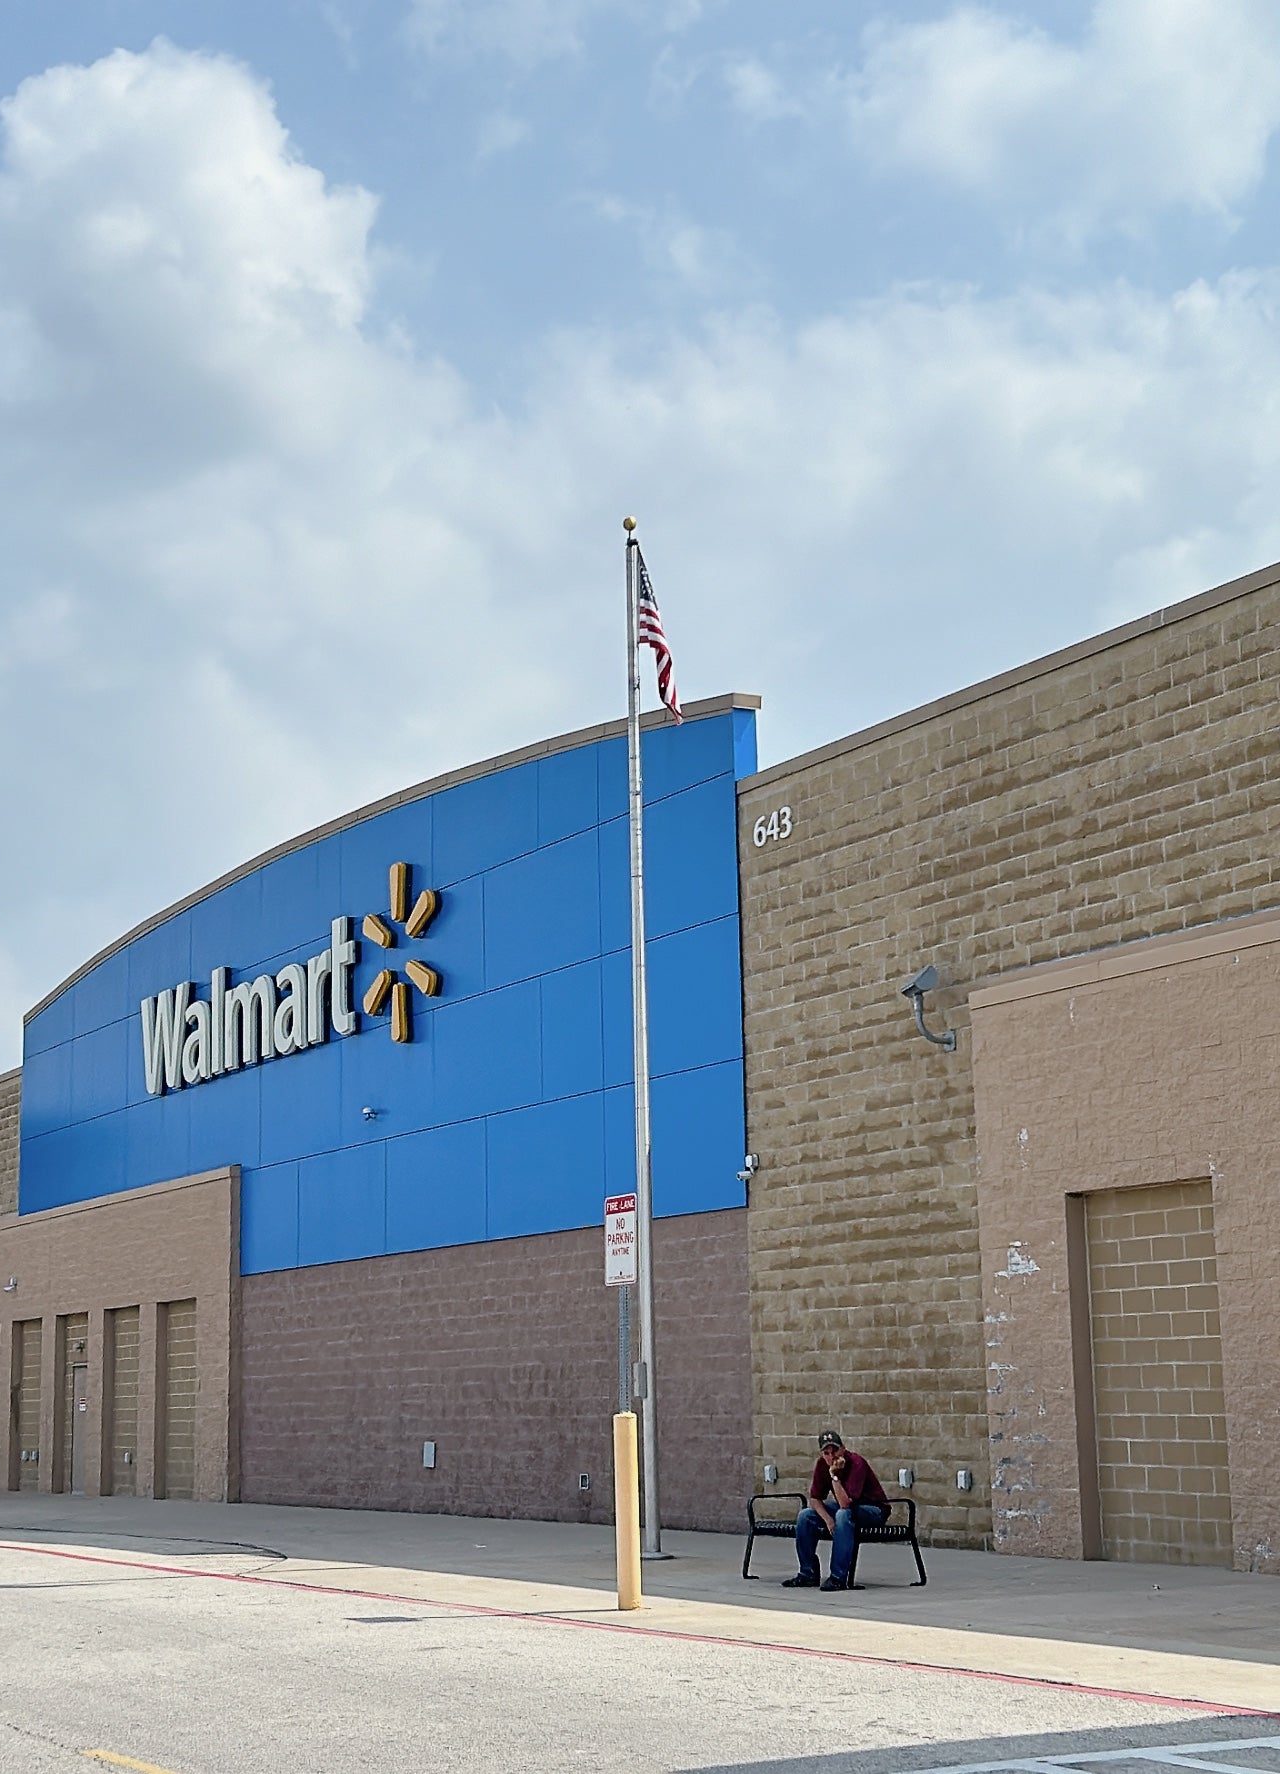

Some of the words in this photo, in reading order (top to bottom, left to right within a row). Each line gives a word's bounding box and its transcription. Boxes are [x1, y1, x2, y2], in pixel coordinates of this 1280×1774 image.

[753, 805, 793, 848] 643
[141, 916, 356, 1095] Walmart
[606, 1201, 619, 1211] FIRE
[620, 1199, 634, 1209] LANE
[616, 1218, 625, 1230] NO
[608, 1232, 633, 1246] PARKING
[612, 1247, 629, 1256] ANYTIME
